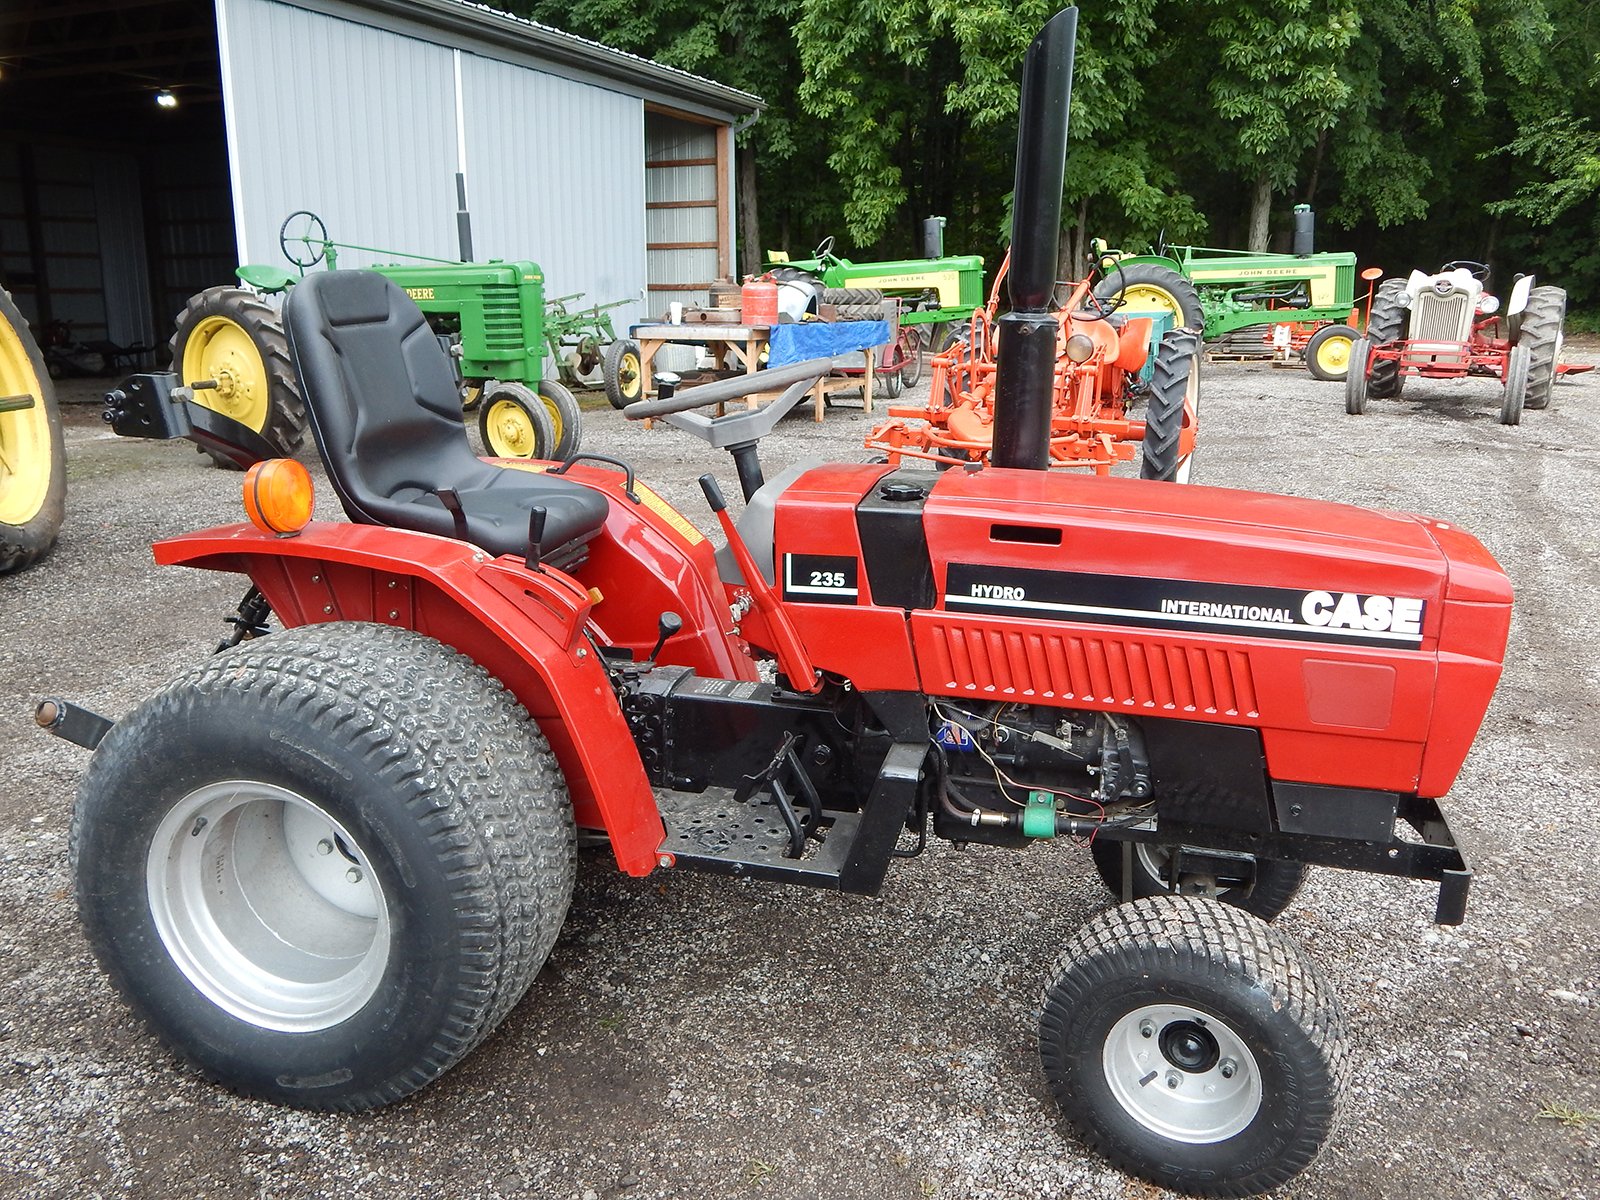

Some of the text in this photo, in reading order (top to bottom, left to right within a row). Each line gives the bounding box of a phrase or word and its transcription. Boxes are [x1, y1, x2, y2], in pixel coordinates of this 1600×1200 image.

[810, 571, 846, 588] 235
[971, 583, 1026, 601] HYDRO
[1160, 590, 1423, 634] INTERNATIONAL CASE
